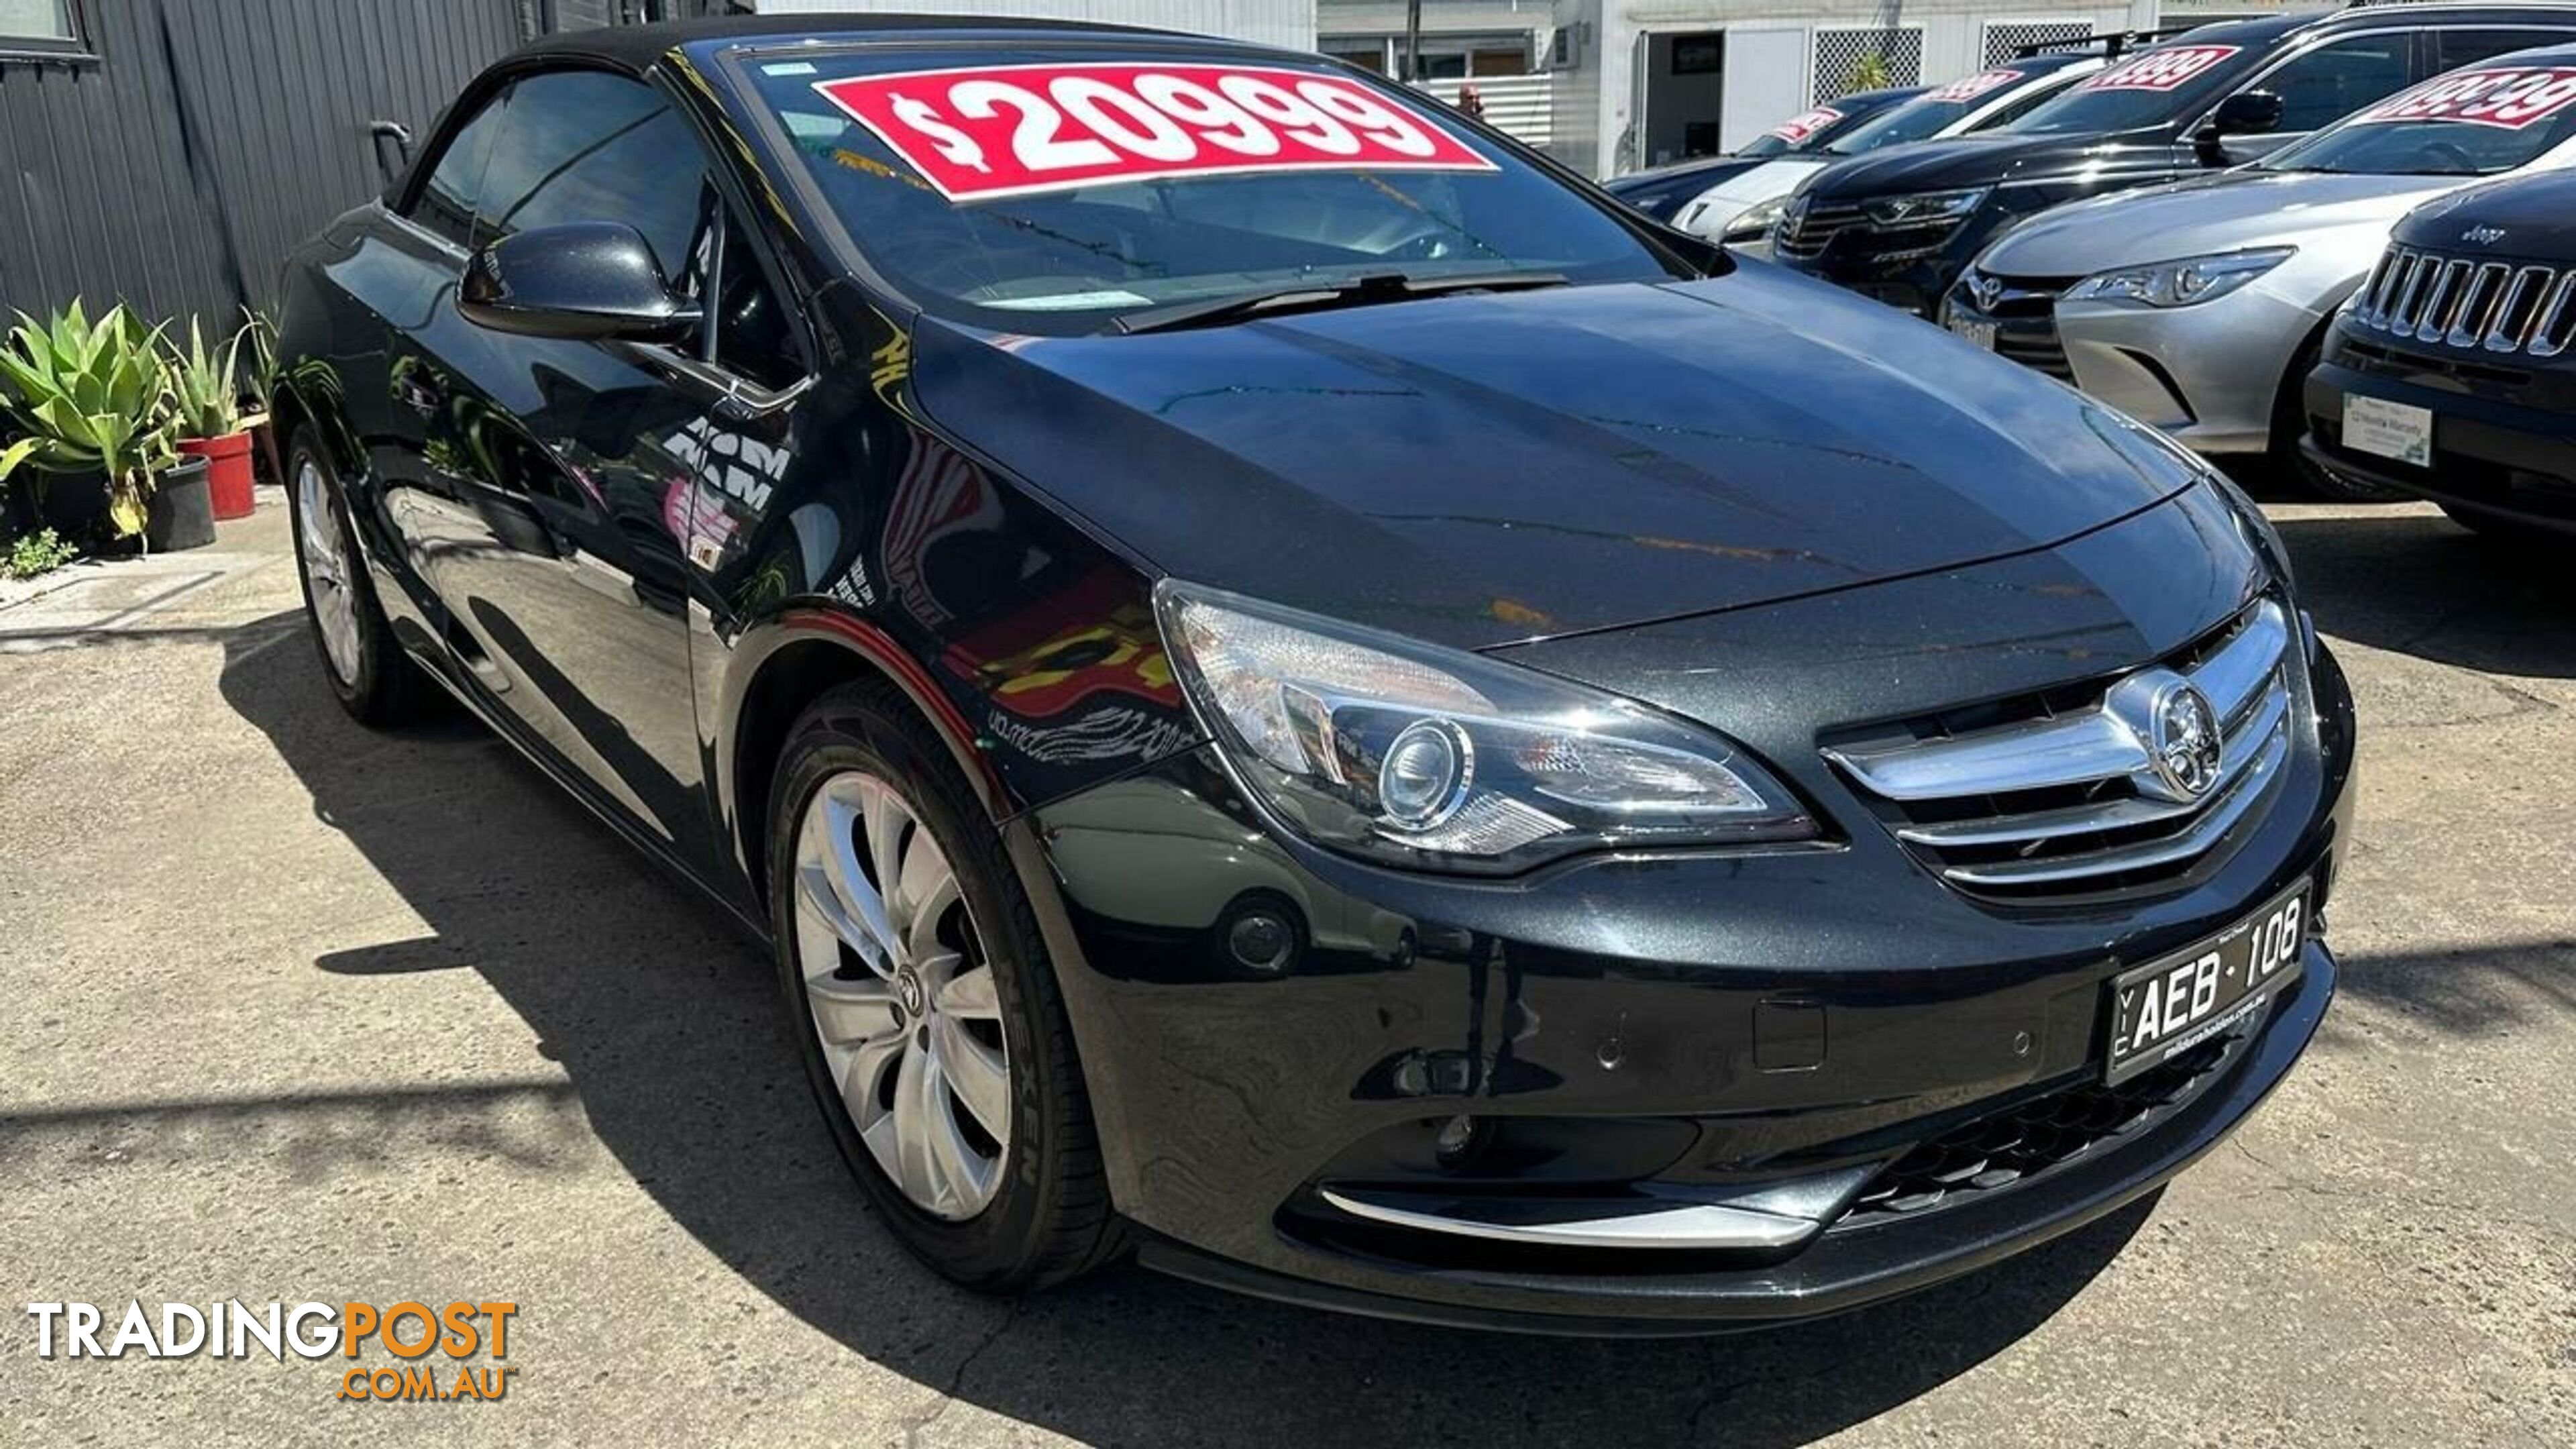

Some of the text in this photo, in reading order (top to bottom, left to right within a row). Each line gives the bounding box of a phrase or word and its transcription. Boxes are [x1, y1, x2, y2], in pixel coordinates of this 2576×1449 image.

[888, 73, 1436, 173] $20999
[1000, 959, 1039, 1186] NEXEN
[2114, 989, 2135, 1057] VIC
